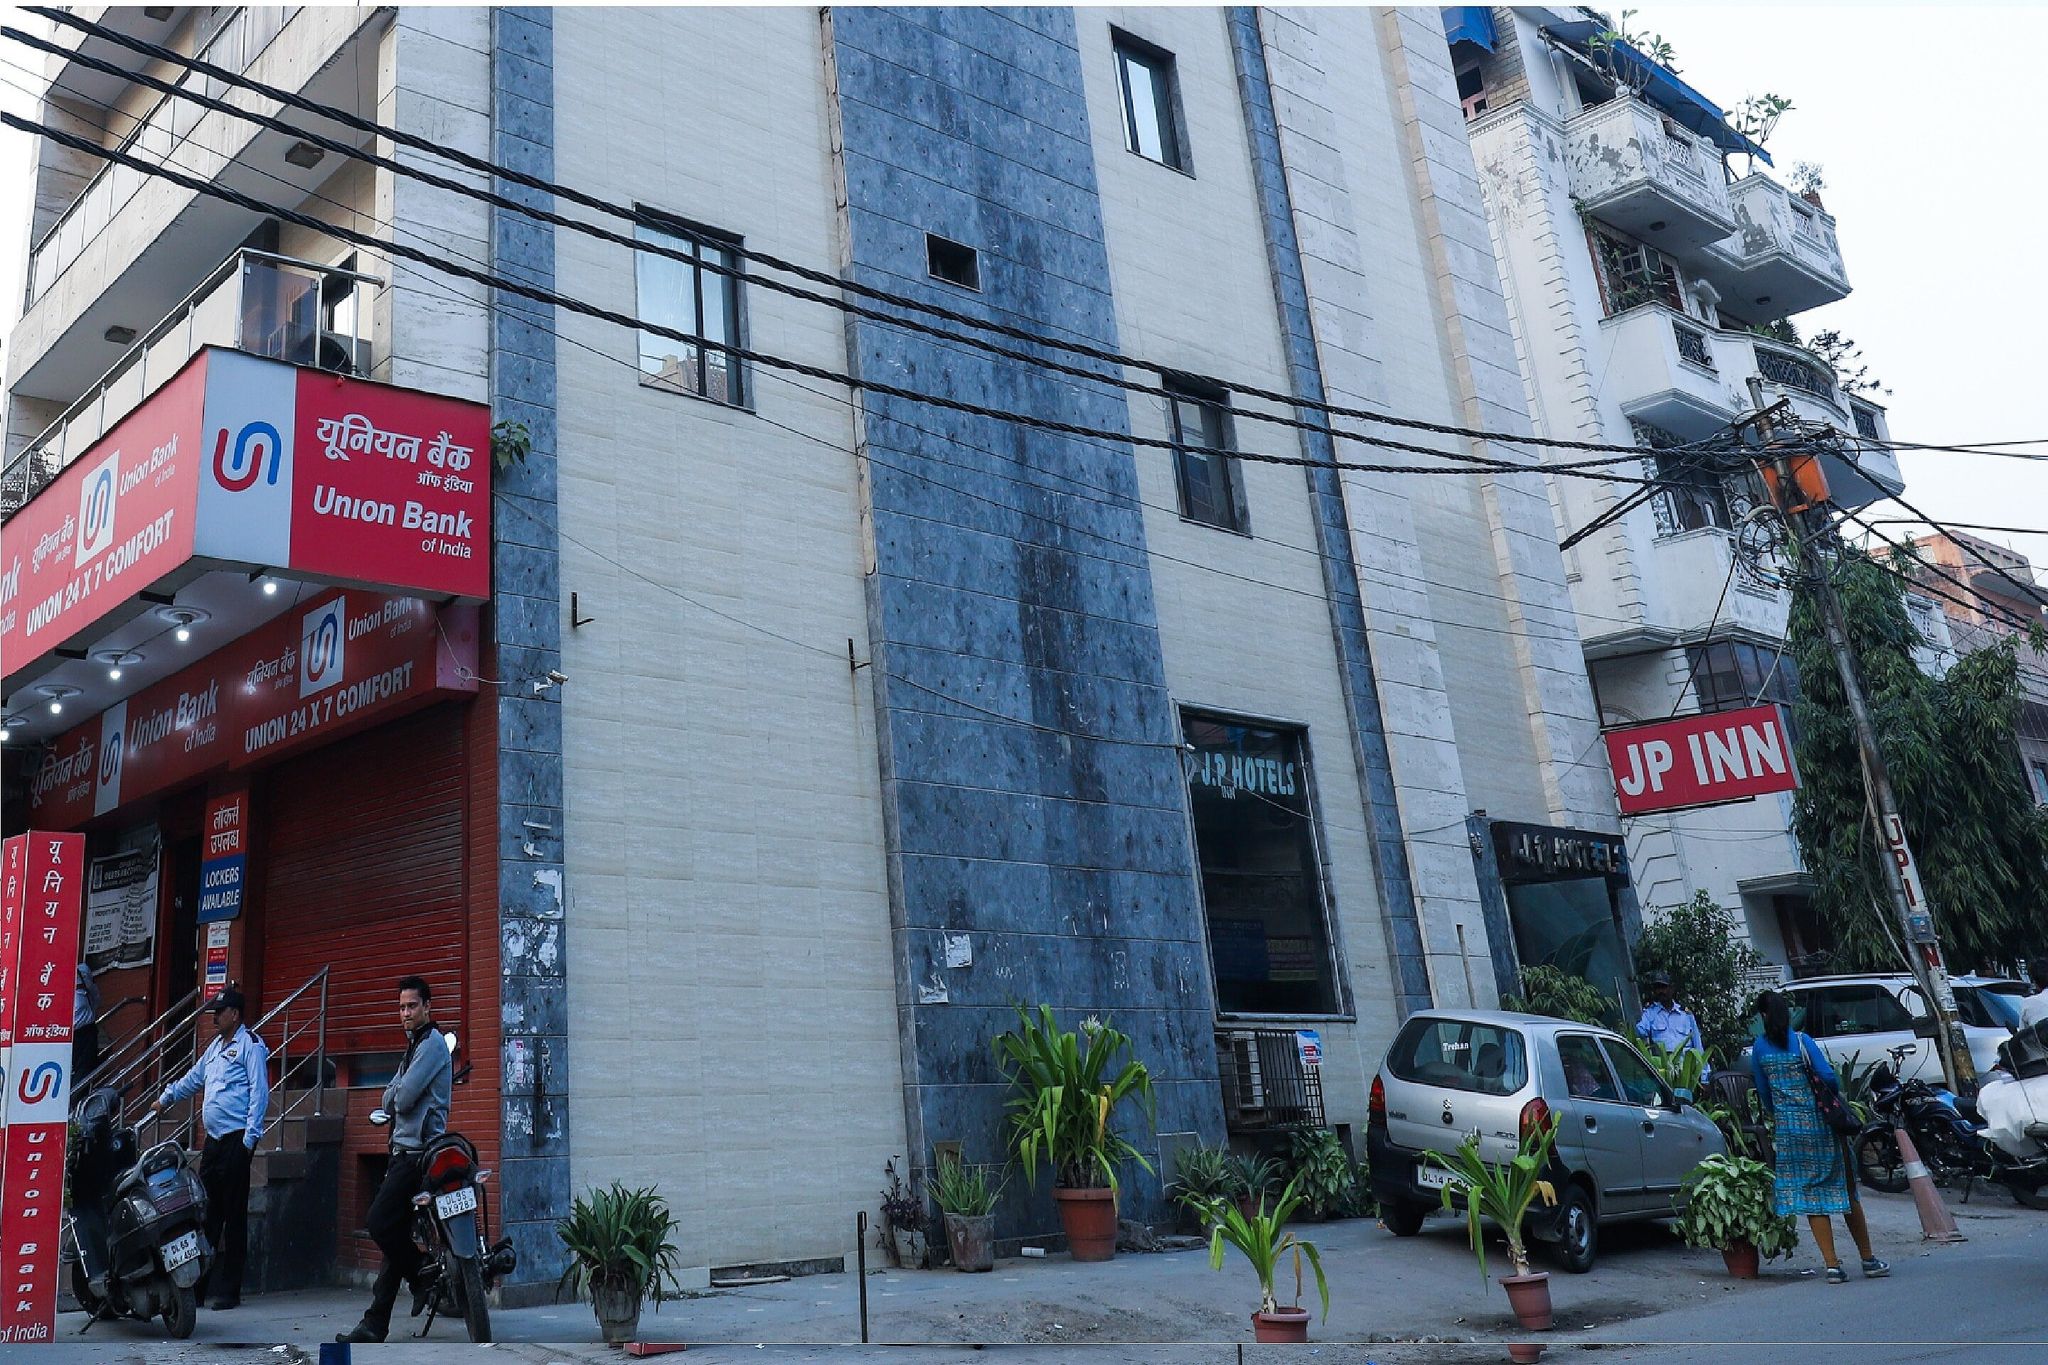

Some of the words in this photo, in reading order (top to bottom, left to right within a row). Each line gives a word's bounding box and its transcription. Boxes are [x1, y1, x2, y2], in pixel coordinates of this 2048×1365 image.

[316, 413, 423, 462] यूनियन
[427, 431, 474, 472] बैंक
[119, 458, 150, 497] Union
[150, 433, 179, 474] Bank
[416, 470, 442, 488] ऑफ
[443, 473, 474, 494] इंडिया
[313, 485, 396, 526] Union
[402, 501, 473, 538] Bank
[421, 537, 437, 553] of
[438, 539, 472, 559] India
[26, 588, 62, 637] UNION
[64, 578, 80, 610] 24
[81, 571, 93, 600] X
[94, 560, 103, 590] 7
[105, 509, 175, 582] COMFORT
[348, 610, 382, 641] Union
[130, 707, 174, 754] Union
[175, 679, 219, 731] Bank
[244, 714, 287, 753] UNION
[290, 706, 306, 737] 24
[310, 702, 321, 728] X
[324, 695, 333, 723] 7
[336, 660, 413, 717] COMFORT
[184, 734, 195, 752] of
[1620, 739, 1674, 797] JP
[1687, 721, 1787, 786] INN
[1232, 755, 1296, 796] HOTELS
[210, 829, 240, 854] उपलब्ध
[205, 866, 240, 888] LOCKERS
[202, 889, 240, 912] AVAILABLE
[13, 1322, 48, 1341] India
